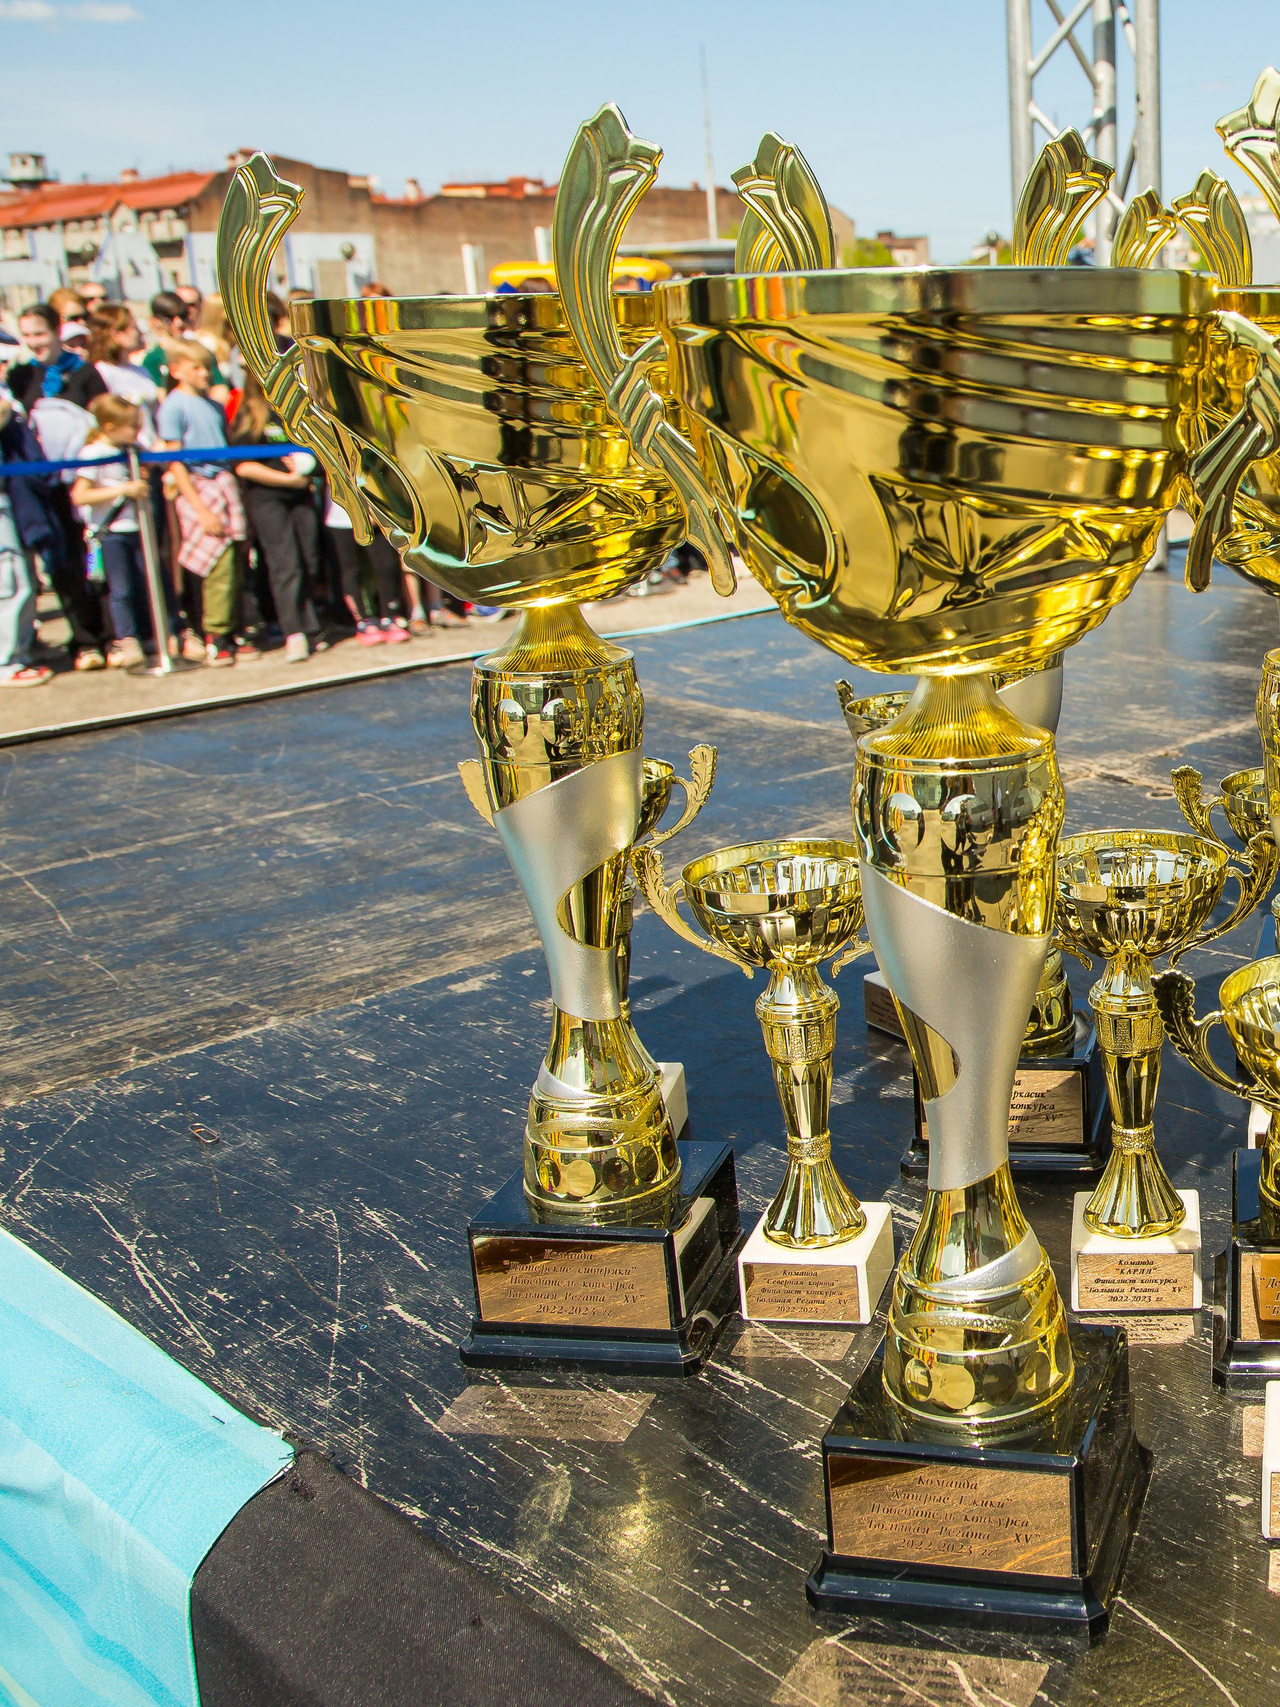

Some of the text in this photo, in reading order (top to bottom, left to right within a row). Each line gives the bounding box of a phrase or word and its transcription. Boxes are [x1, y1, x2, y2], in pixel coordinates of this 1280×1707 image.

[1010, 1103, 1054, 1112] конкурса
[543, 1249, 593, 1260] Команда
[510, 1275, 635, 1290] Победитель конкурса
[564, 1292, 605, 1302] Регата
[536, 1305, 596, 1317] 2022-2023
[776, 1306, 818, 1314] 2022-2023
[917, 1475, 978, 1490] Команда
[870, 1503, 1029, 1528] Победитель конкурса
[938, 1526, 991, 1540] Регата
[898, 1539, 973, 1555] 2022-2023
